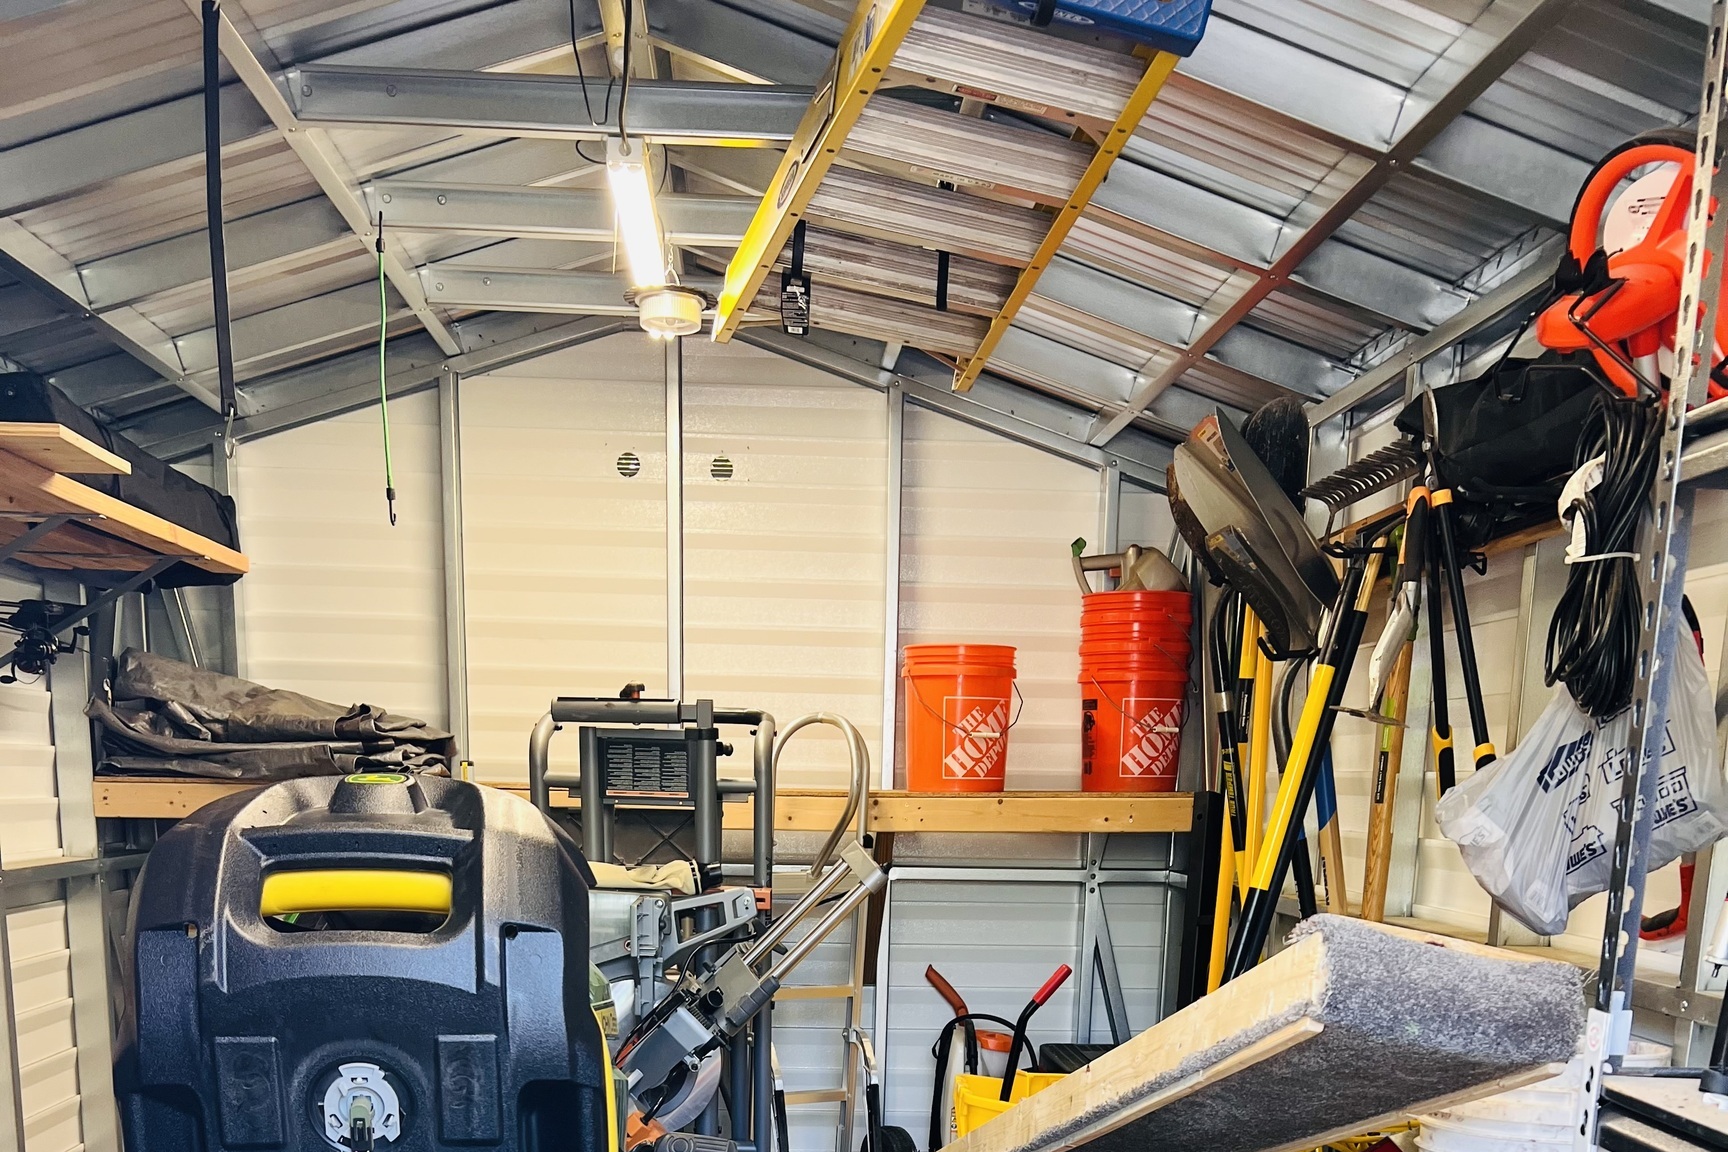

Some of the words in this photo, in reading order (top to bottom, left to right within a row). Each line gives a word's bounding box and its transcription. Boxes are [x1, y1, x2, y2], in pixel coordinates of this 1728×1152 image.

[944, 699, 1007, 778] HOME
[952, 706, 986, 738] THE
[1129, 706, 1164, 739] THE
[973, 733, 1007, 778] DEPO
[1149, 733, 1181, 776] DEPO
